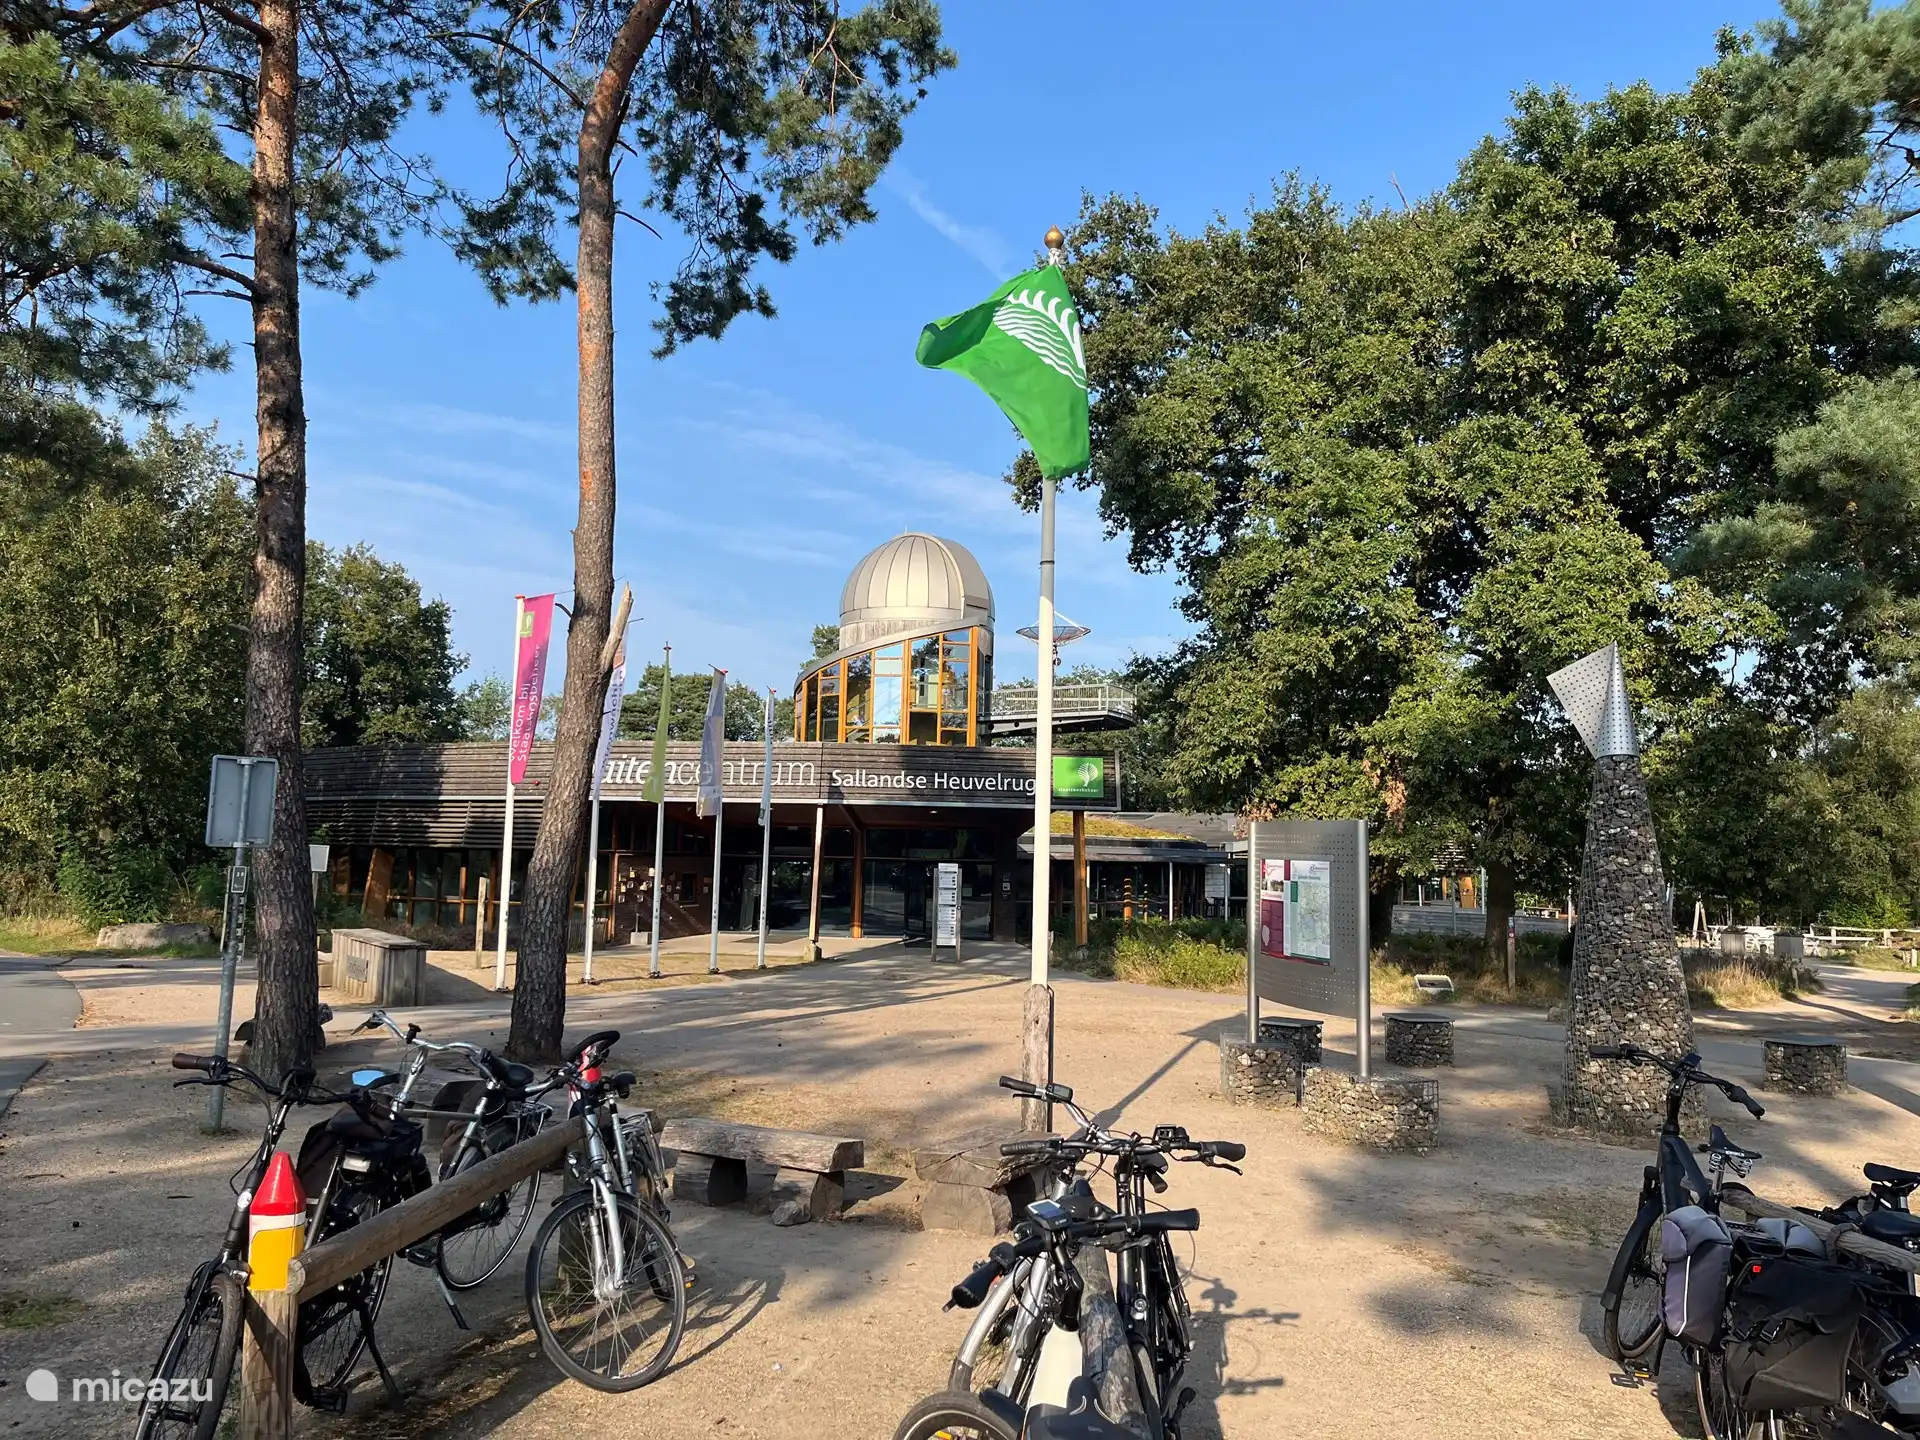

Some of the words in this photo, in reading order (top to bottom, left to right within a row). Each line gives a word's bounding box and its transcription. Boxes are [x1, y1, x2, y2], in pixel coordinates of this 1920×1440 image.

[519, 682, 531, 700] bij
[592, 754, 817, 787] uitencentrum
[831, 769, 928, 789] Sallandse
[934, 772, 1036, 796] Heuvelrug
